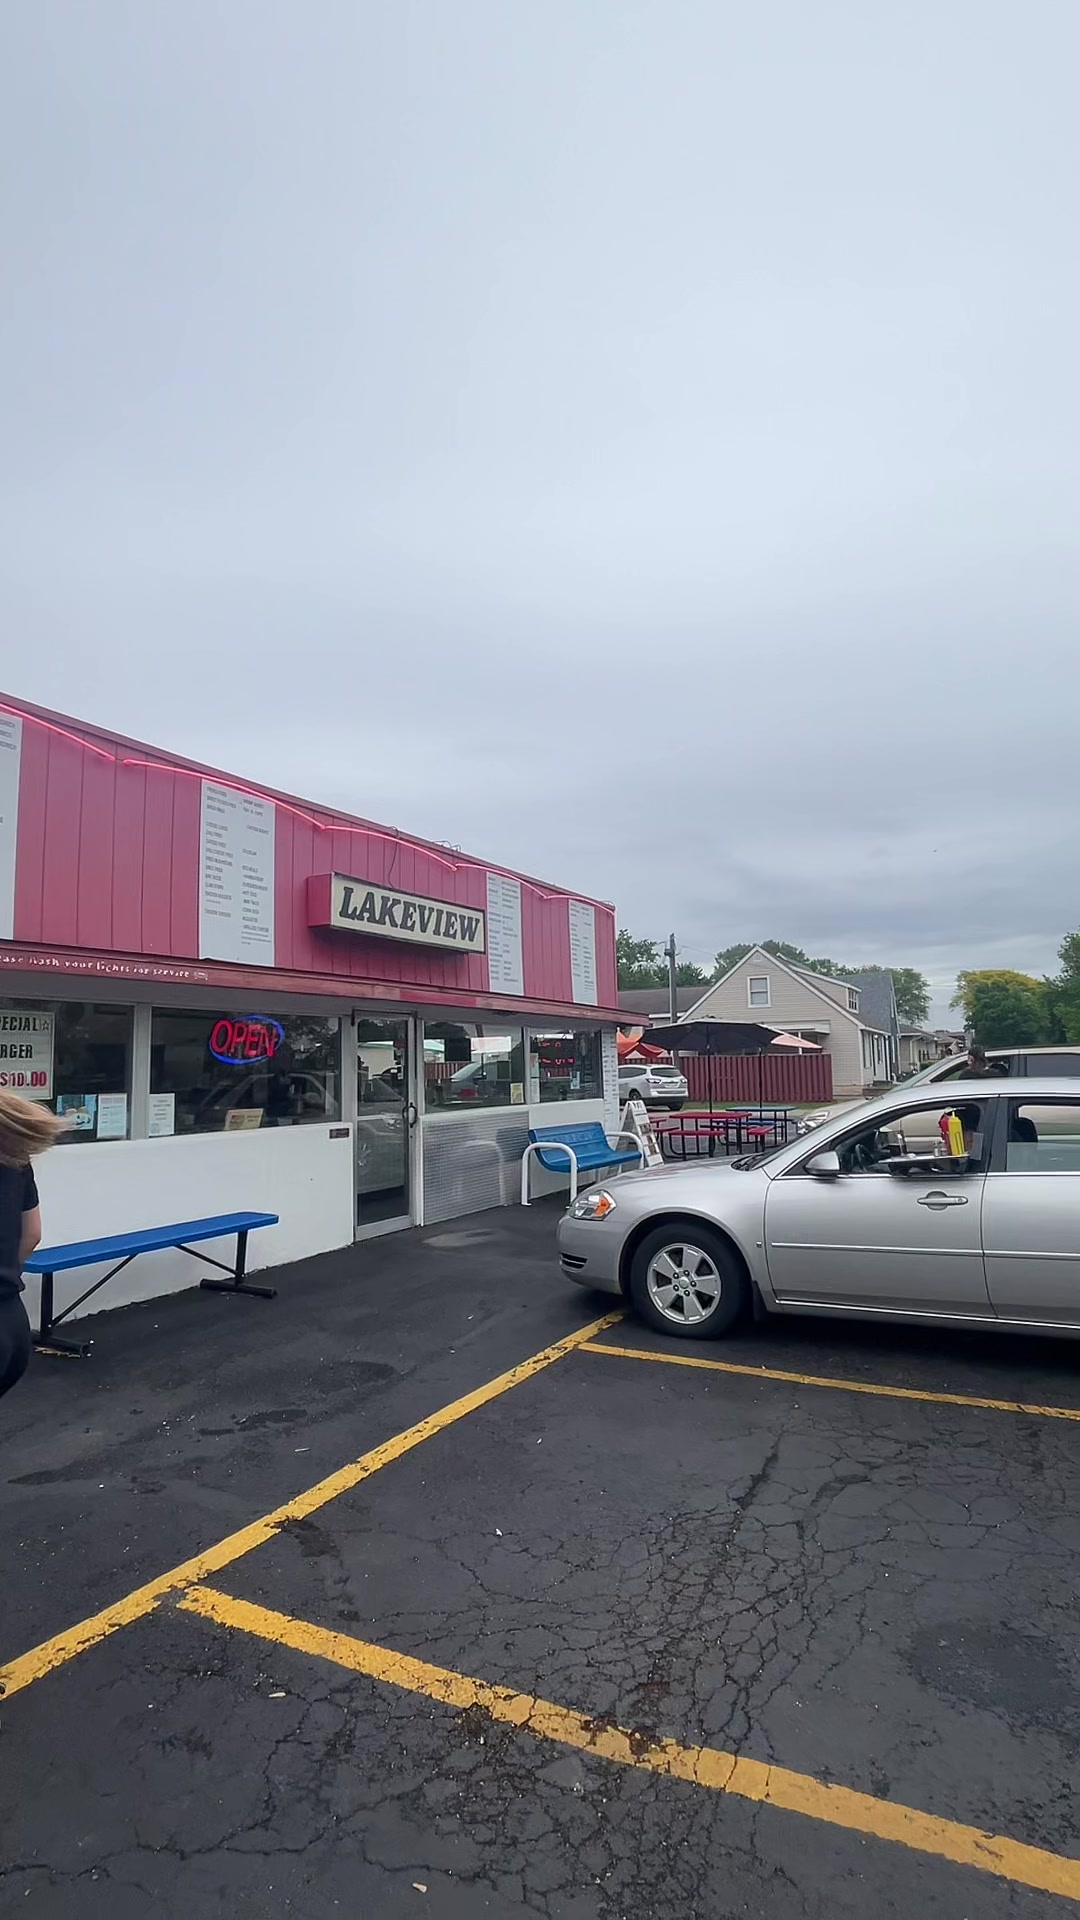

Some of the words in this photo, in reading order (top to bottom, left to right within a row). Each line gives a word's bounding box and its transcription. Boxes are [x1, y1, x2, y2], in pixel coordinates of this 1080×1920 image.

[339, 886, 480, 942] LAKEVIEW
[0, 1016, 39, 1031] ECIAL
[210, 1019, 278, 1057] OPEN
